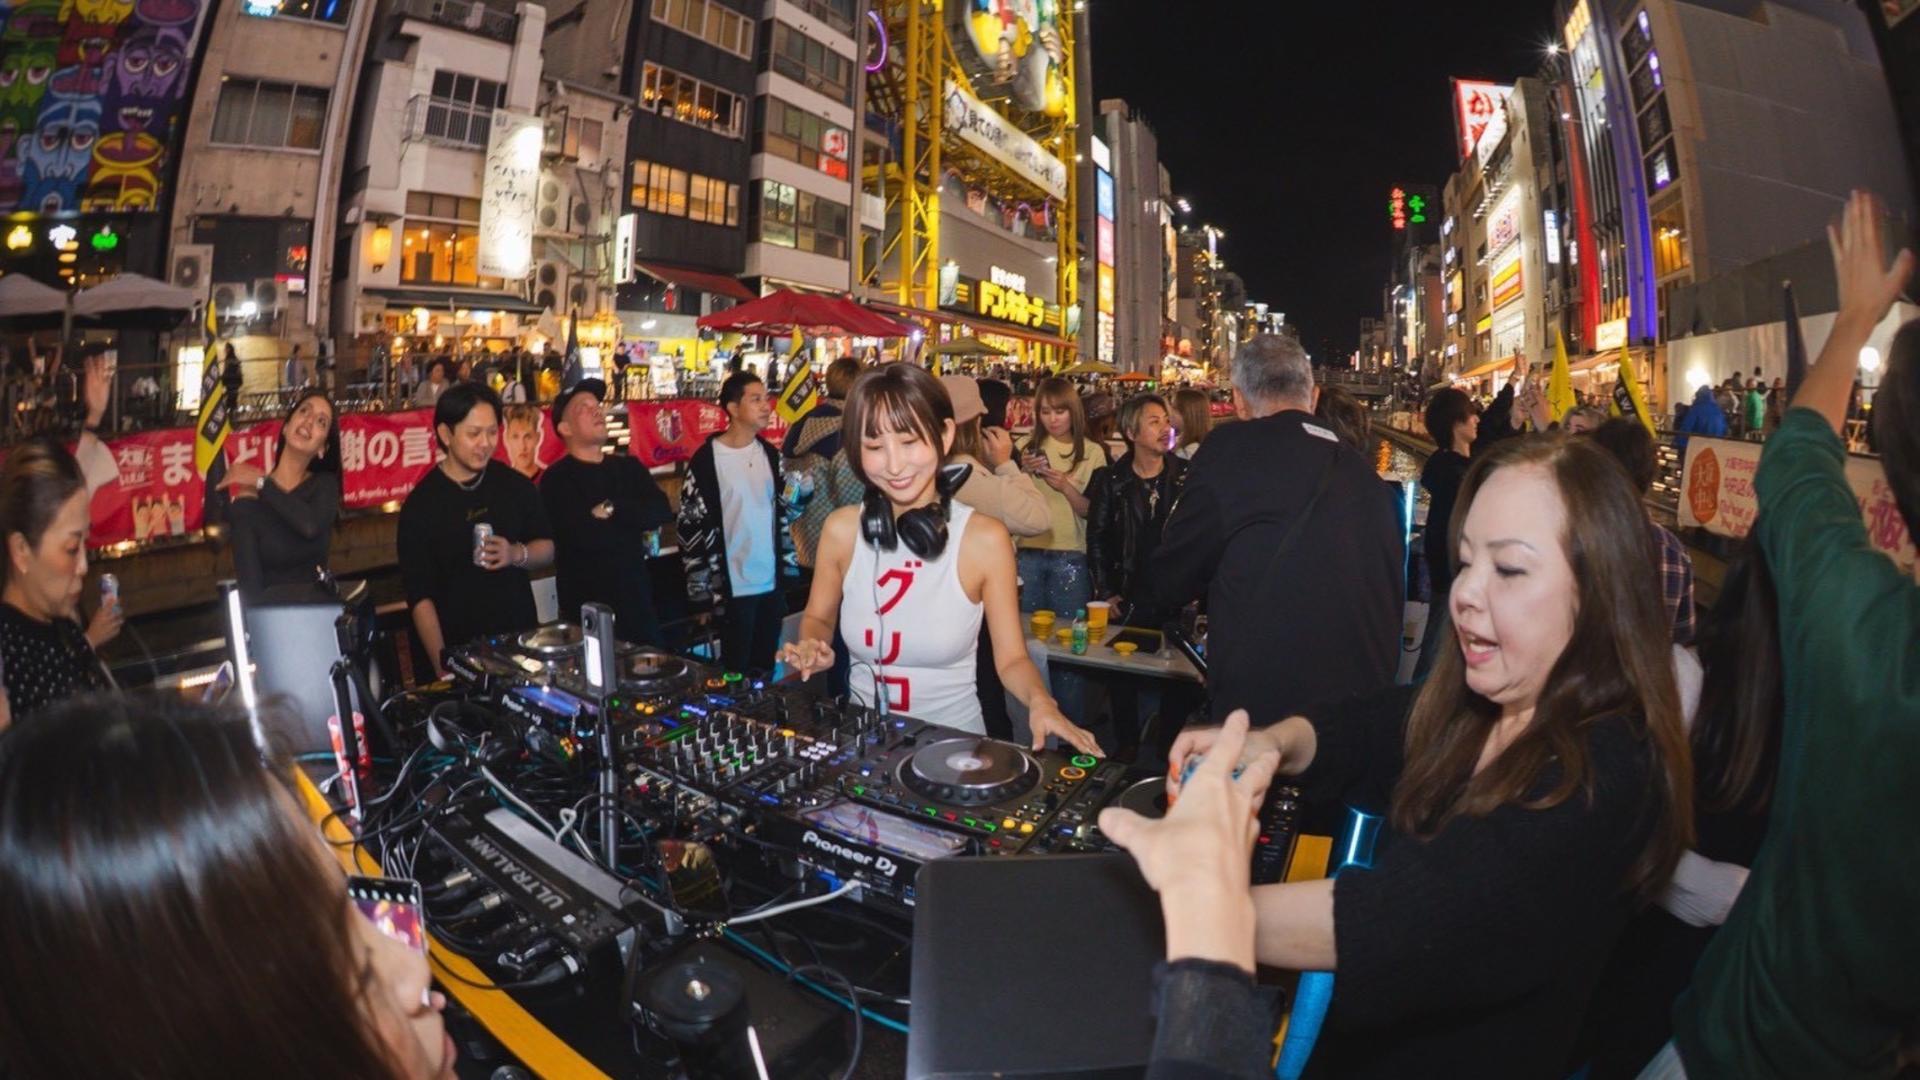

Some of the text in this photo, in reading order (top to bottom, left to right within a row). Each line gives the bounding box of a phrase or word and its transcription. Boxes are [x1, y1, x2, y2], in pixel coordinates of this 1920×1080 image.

[465, 834, 564, 910] ULTRALINK
[803, 830, 898, 877] Pioneer DJ
